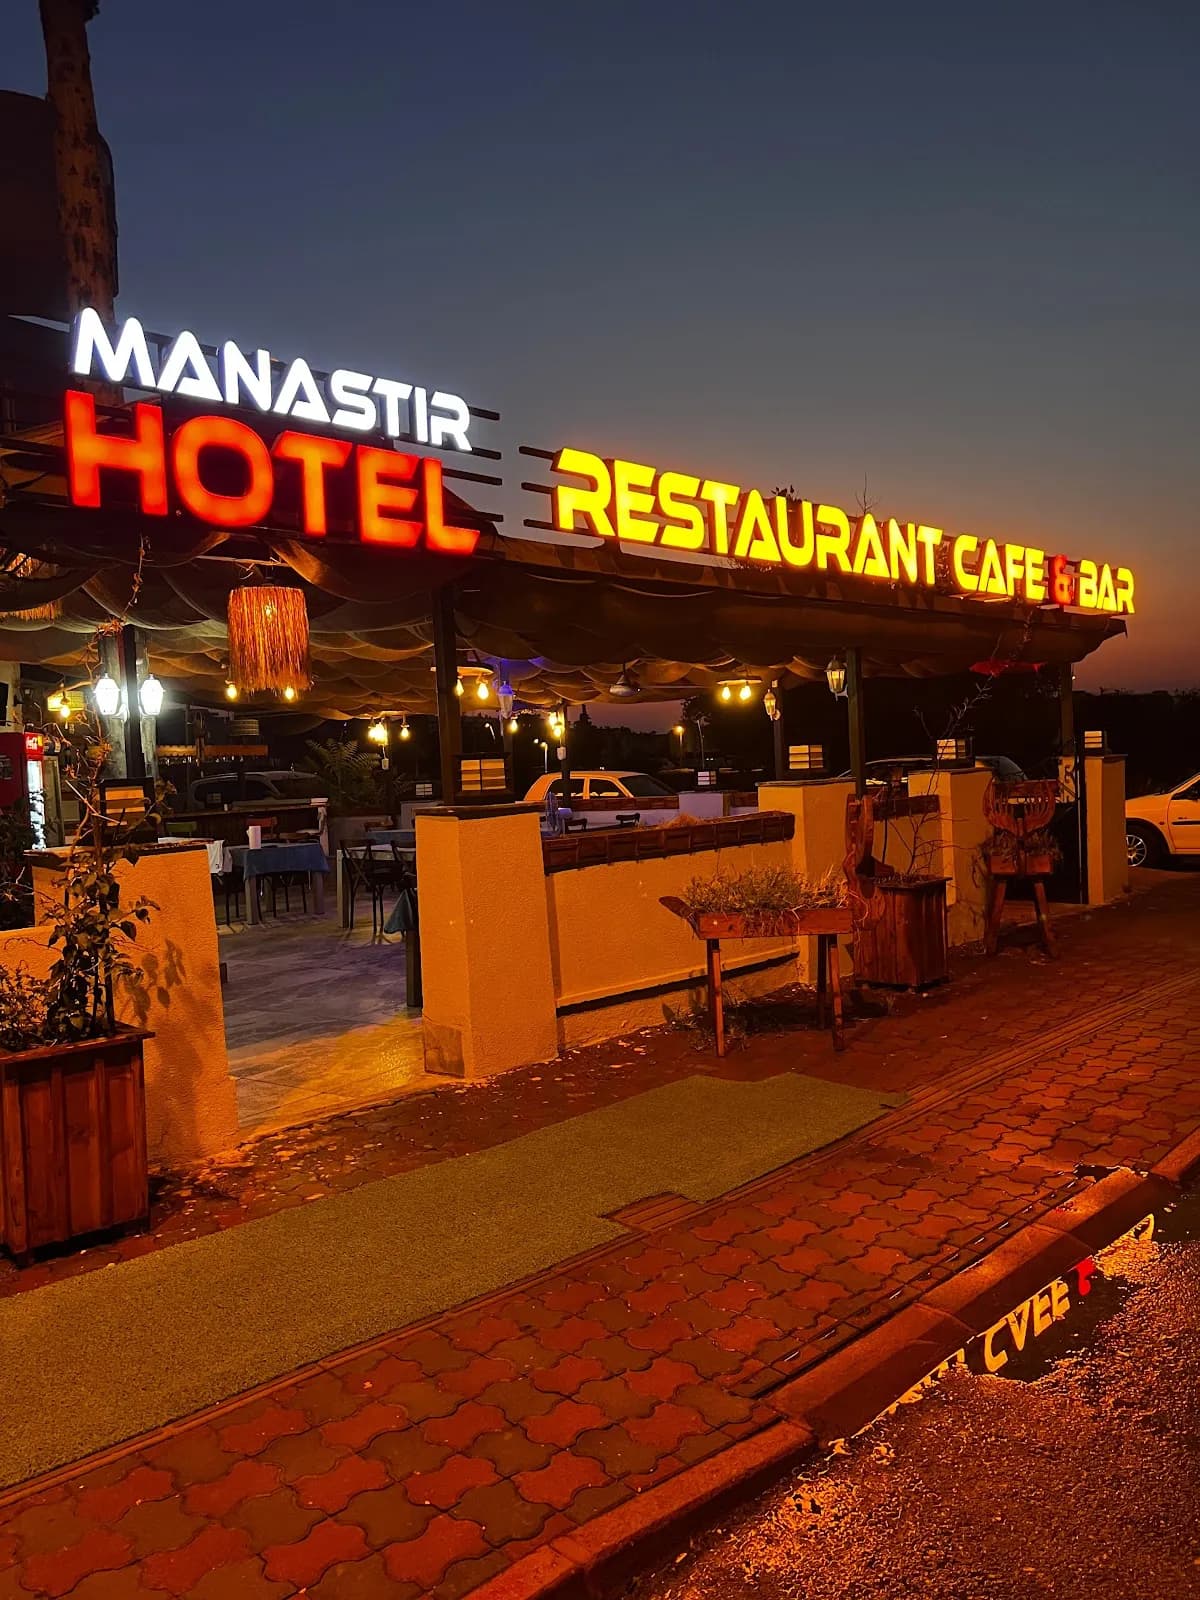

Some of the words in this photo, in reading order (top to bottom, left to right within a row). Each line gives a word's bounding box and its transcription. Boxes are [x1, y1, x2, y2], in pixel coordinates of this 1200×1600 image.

[72, 306, 472, 451] MANASTIR
[65, 389, 480, 555] HOTEL
[555, 447, 943, 585] RESTAURANT
[953, 534, 1046, 601] CAFE
[1052, 554, 1073, 605] &
[1079, 559, 1135, 614] BAR
